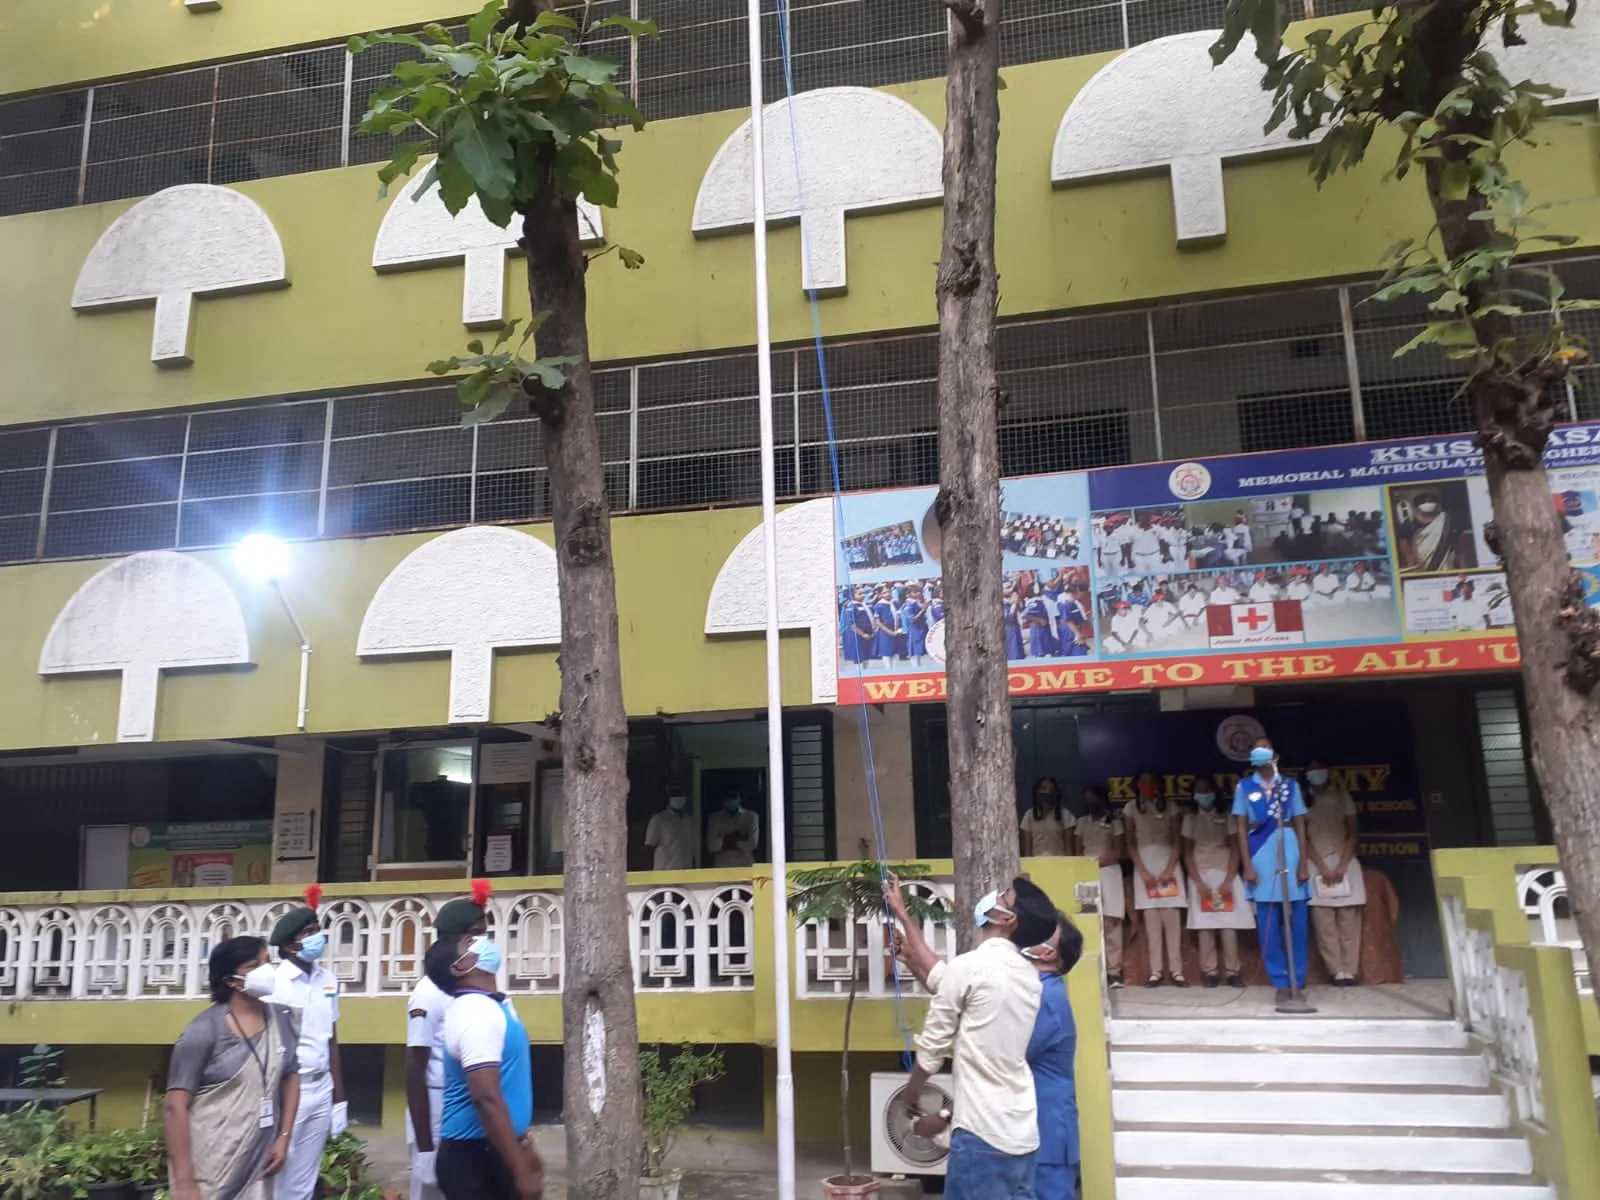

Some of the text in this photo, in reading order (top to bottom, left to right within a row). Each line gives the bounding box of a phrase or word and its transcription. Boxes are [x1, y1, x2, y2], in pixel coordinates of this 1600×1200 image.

[1239, 469, 1344, 488] MEMORIAL
[1131, 661, 1205, 685] TO
[1222, 655, 1335, 680] THE
[1354, 647, 1458, 672] ALL
